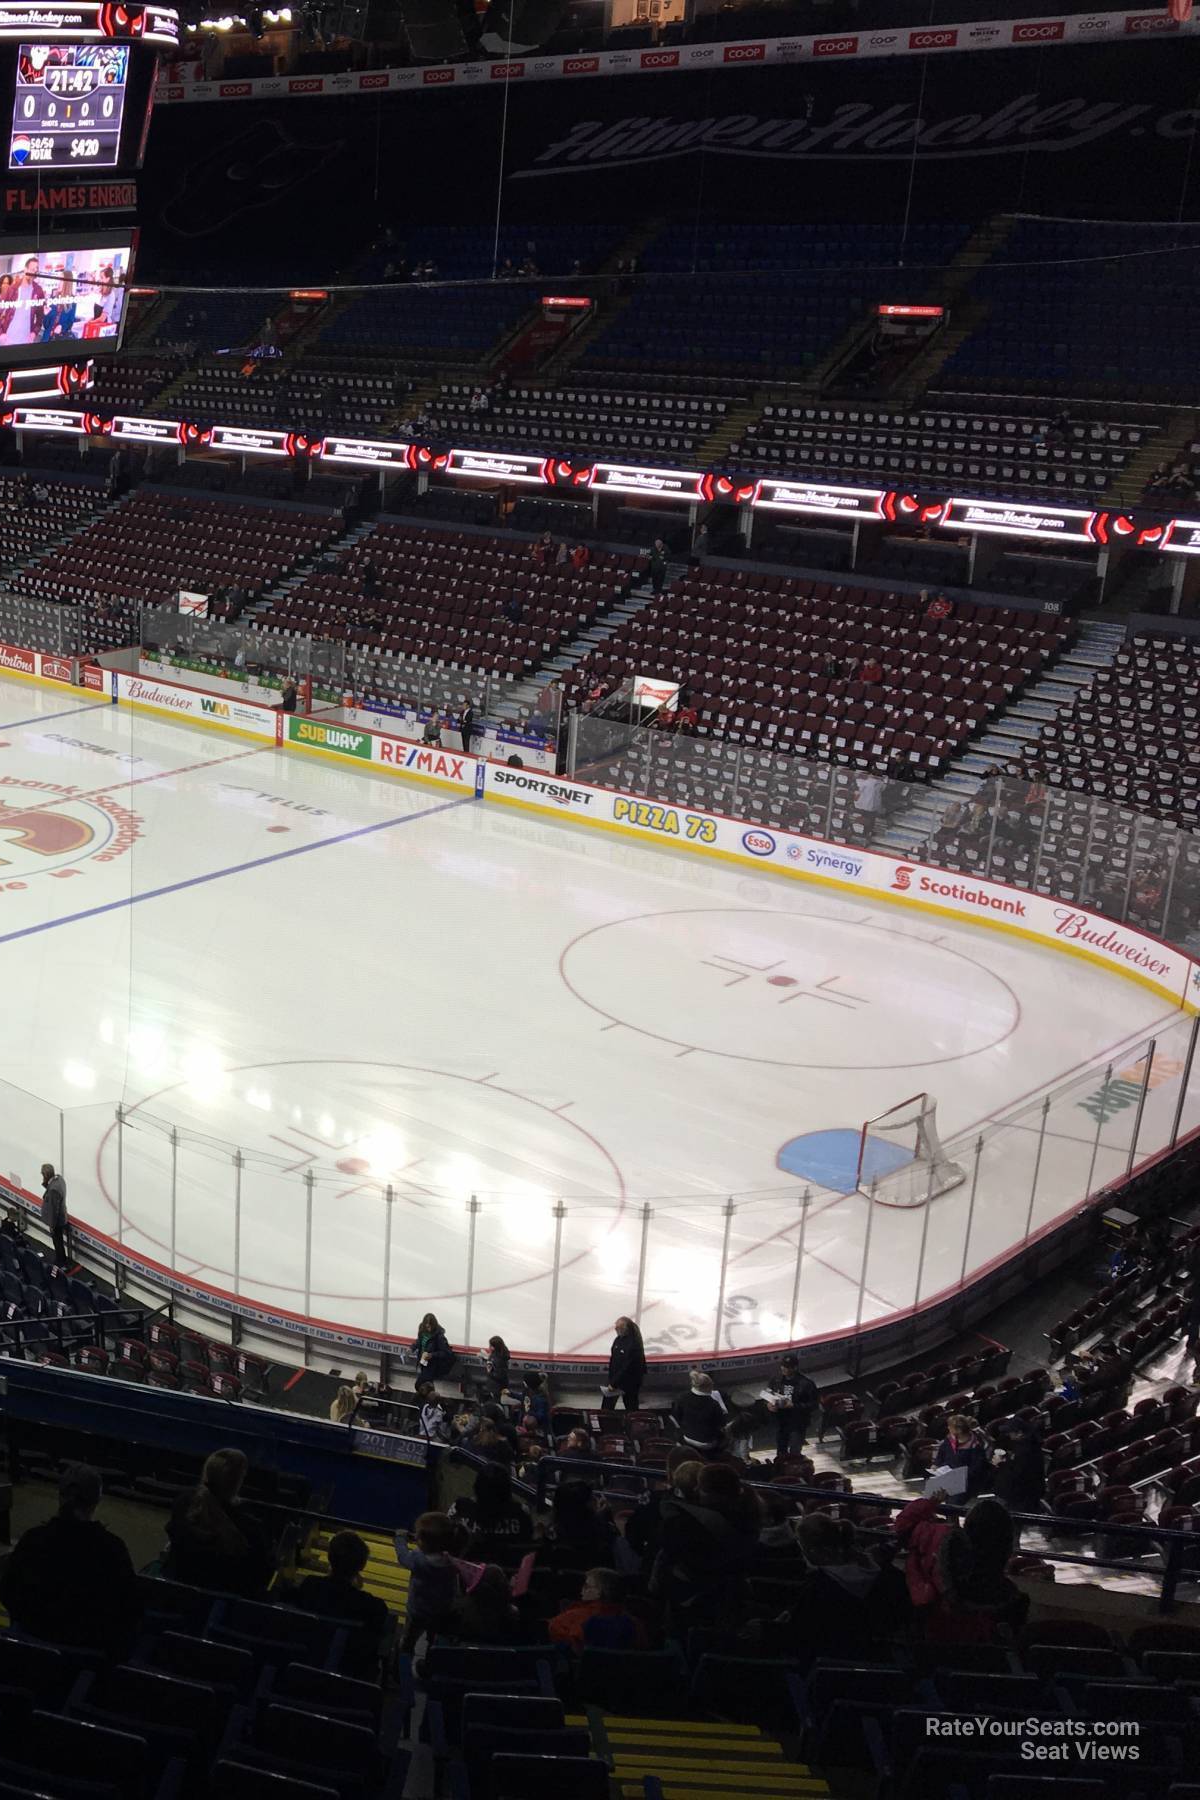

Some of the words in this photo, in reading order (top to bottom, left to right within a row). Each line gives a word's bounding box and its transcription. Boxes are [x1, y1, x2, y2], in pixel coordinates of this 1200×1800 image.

[644, 54, 677, 65] CO-OP
[728, 47, 761, 59] CO-OP
[818, 40, 854, 52] CO-OP
[869, 36, 898, 45] CO-OP
[914, 33, 952, 46] CO-OP
[1017, 25, 1059, 38] CO-OP
[50, 70, 93, 92] 21:42
[223, 86, 249, 96] CO-OP
[291, 81, 320, 91] CO-OP
[362, 76, 387, 86] CO-OP
[426, 71, 452, 82] CO-OP
[566, 60, 596, 71] CO-OP
[23, 95, 35, 118] 0
[48, 102, 56, 117] 0
[81, 102, 89, 117] 0
[102, 95, 113, 118] 0
[29, 137, 54, 149] 50/50
[30, 149, 52, 160] TOTAL
[70, 138, 99, 158] $420
[6, 186, 86, 211] FLAMES
[964, 506, 1065, 529] HitmenHockey.com
[125, 677, 193, 711] Budweiser
[200, 697, 231, 717] WM
[297, 723, 364, 751] SUBWAY
[380, 740, 465, 781] RE/MAX
[493, 770, 594, 805] SPORTSNET
[256, 791, 333, 816] TELUS
[86, 794, 147, 863] Saddledome
[612, 797, 679, 834] PIZZA
[686, 814, 718, 843] 73
[807, 848, 863, 877] Synergy
[919, 876, 1026, 918] Scotiabank
[1053, 908, 1171, 977] Budweiser
[212, 1296, 233, 1310] KEEPING
[239, 1306, 257, 1318] FRESH
[285, 1321, 308, 1333] KEEPING
[316, 1328, 335, 1340] FRESH
[366, 1341, 392, 1352] KEEPING
